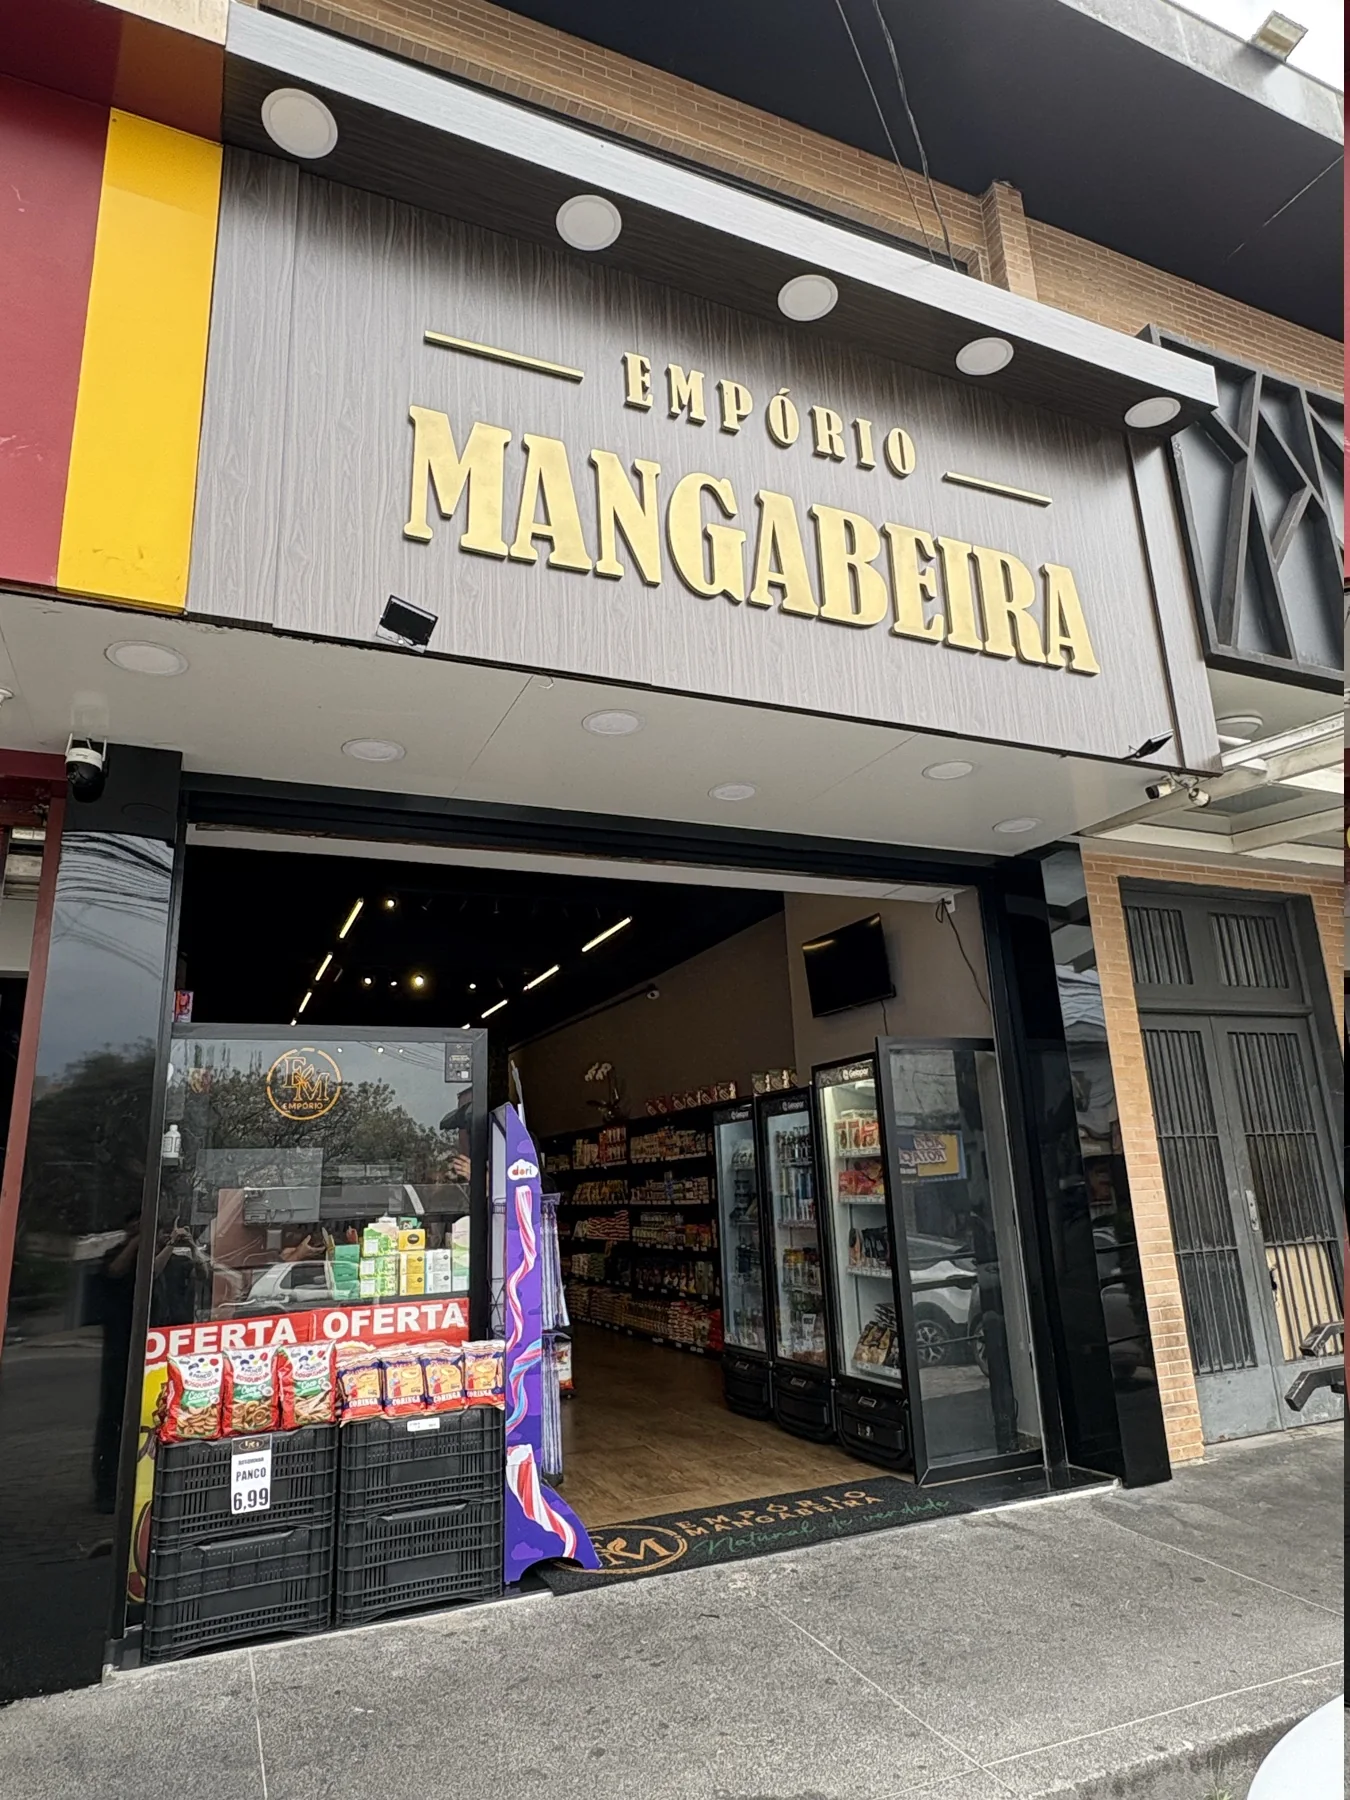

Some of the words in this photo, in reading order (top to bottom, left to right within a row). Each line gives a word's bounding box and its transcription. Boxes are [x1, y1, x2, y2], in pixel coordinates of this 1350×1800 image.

[623, 352, 916, 478] EMPÓRIO
[403, 405, 1100, 676] MANGABEIRA
[281, 1101, 323, 1110] EMPÓRIO
[511, 1165, 533, 1177] dori
[146, 1317, 298, 1359] OFERTA
[323, 1302, 467, 1339] OFERTA
[348, 1397, 378, 1408] CORINGA
[391, 1395, 420, 1406] CORINGA
[433, 1390, 460, 1403] CORINGA
[235, 1467, 267, 1482] PANCO
[233, 1487, 269, 1511] 6,99
[675, 1490, 866, 1529] EMPÓRIO
[684, 1496, 885, 1537] MANGABEIRA
[692, 1519, 816, 1556] Natural
